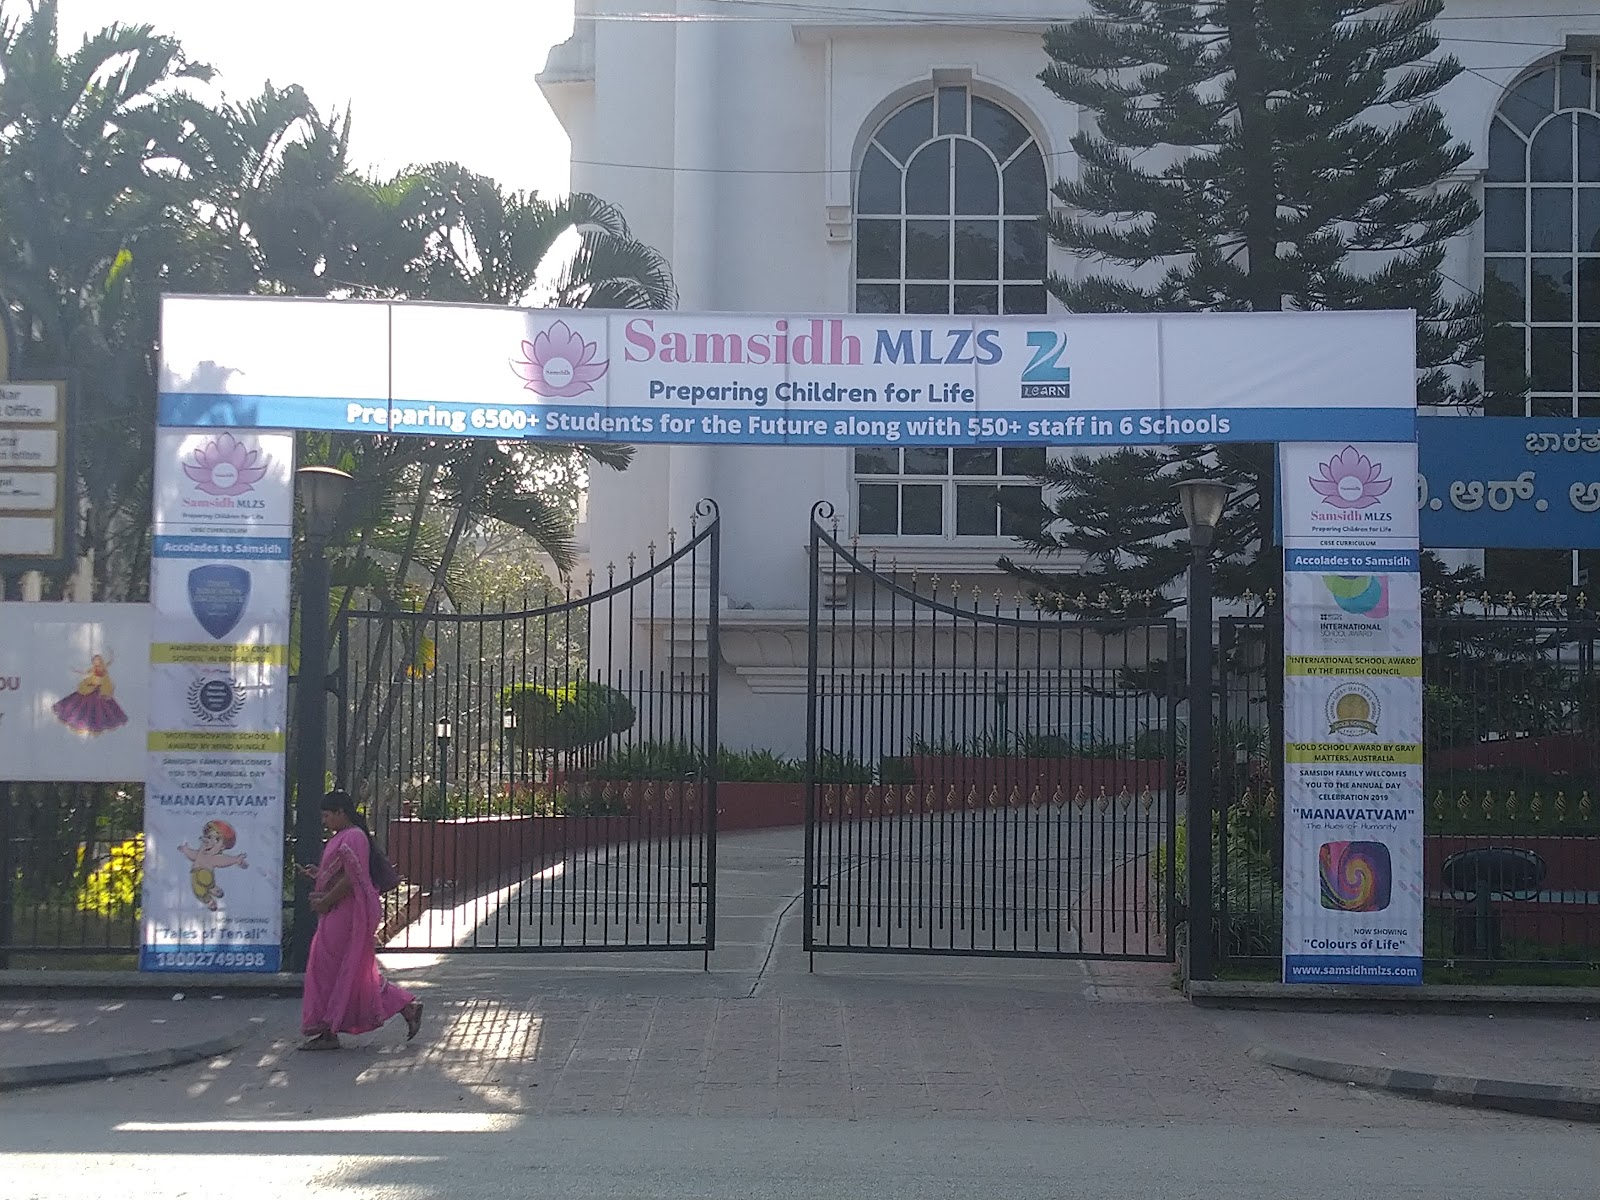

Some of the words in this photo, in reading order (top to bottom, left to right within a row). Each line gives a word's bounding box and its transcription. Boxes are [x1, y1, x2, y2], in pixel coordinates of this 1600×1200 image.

[624, 318, 864, 366] Samsidh
[873, 329, 1003, 365] MLZS
[649, 380, 767, 406] Preparing
[775, 381, 877, 402] Children
[884, 382, 921, 403] for
[928, 383, 975, 403] Life
[347, 403, 466, 433] Preparing
[471, 408, 540, 430] 6500+
[545, 412, 654, 434] Students
[660, 412, 696, 434] for
[701, 415, 742, 434] the
[748, 416, 828, 436] Future
[834, 416, 901, 440] along
[906, 416, 961, 436] with
[967, 418, 1022, 437] 550+
[1028, 416, 1084, 436] staff
[1091, 416, 1113, 436] in
[1120, 416, 1133, 435] 6
[1138, 414, 1230, 436] Schools
[182, 498, 235, 508] Samsidh
[236, 499, 265, 508] MLZS
[1311, 511, 1361, 521] Samsidh
[1363, 512, 1392, 521] MLZS
[1311, 526, 1342, 534] Preparing
[163, 542, 219, 553] Accolades
[221, 543, 233, 553] to
[235, 543, 282, 554] Samsidh
[1295, 556, 1350, 566] Accolades
[1352, 557, 1363, 566] to
[1365, 556, 1411, 566] Samsidh
[1320, 623, 1382, 631] INTERNATIONAL
[1355, 657, 1386, 665] SCHOOL
[1366, 668, 1401, 676] COUNCIL
[1353, 744, 1382, 752] AWARD
[1383, 744, 1393, 752] BY
[1299, 769, 1334, 777] SAMSIDH
[1336, 769, 1364, 777] FAMILY
[1365, 770, 1407, 778] WELCOMES
[1318, 793, 1370, 801] CELEBRATION
[1293, 808, 1415, 821] "MANAVATVAM"
[1305, 822, 1322, 830] The
[1346, 821, 1358, 830] of
[1353, 928, 1372, 936] NOW
[1373, 928, 1408, 936] SHOWING
[1304, 939, 1358, 950] "Colours
[1360, 939, 1373, 950] of
[1376, 939, 1406, 950] Life"
[157, 952, 265, 966] 18002749998
[1292, 965, 1417, 977] www.samsidhmlzs.com
